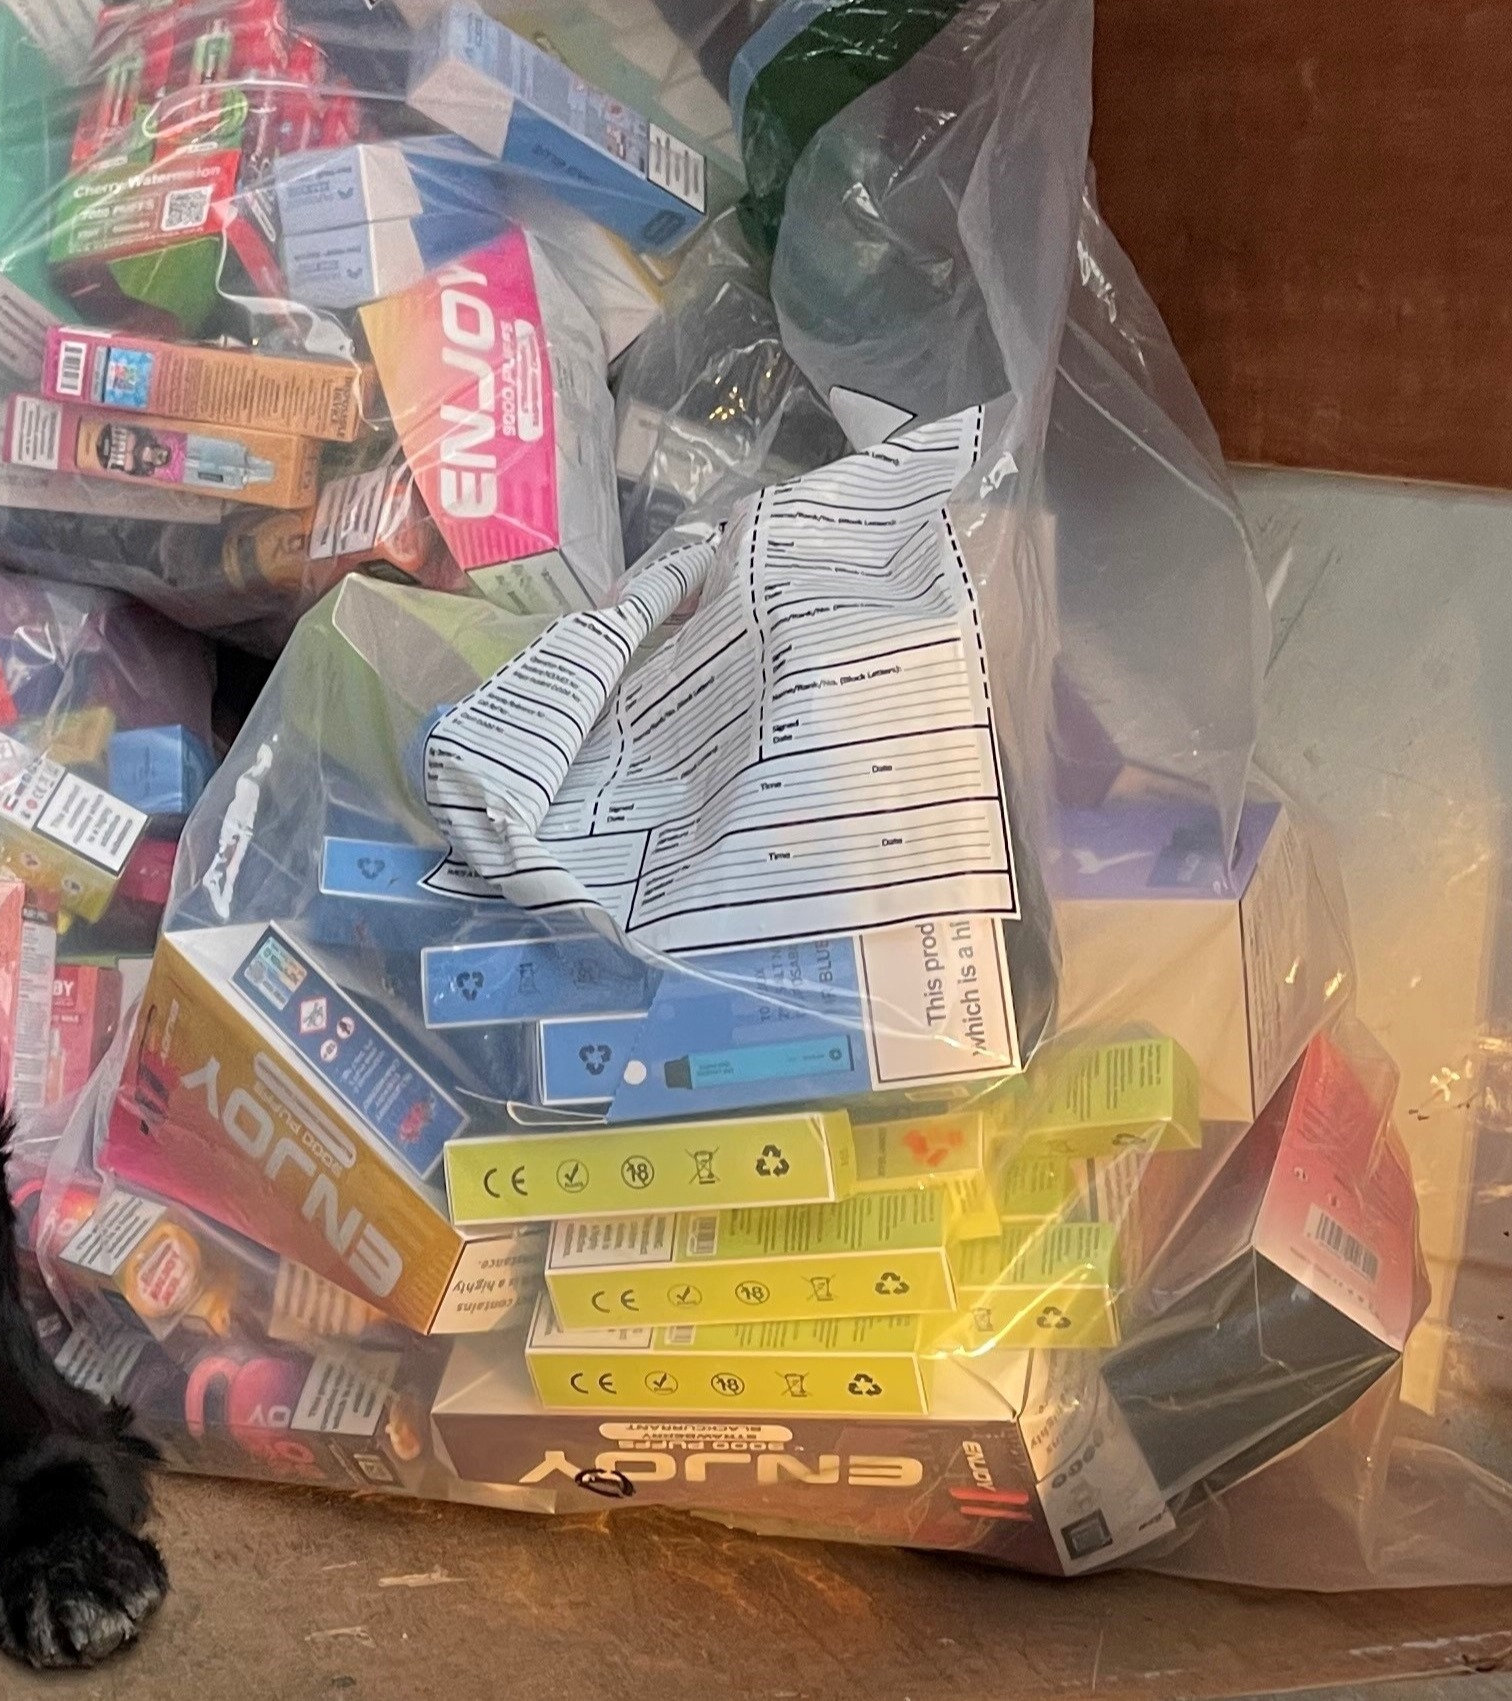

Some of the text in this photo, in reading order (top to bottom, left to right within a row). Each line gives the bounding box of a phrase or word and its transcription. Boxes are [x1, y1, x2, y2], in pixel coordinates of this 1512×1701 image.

[73, 182, 122, 198] Cherry
[438, 263, 498, 518] ENJOY
[773, 718, 800, 733] Signed
[773, 733, 793, 744] Date
[760, 764, 893, 792] Time Date
[768, 837, 903, 861] Time Date
[915, 921, 946, 1027] This prod
[949, 920, 987, 1057] which is a hi
[179, 1054, 405, 1299] ENJOY
[626, 1164, 649, 1182] 18
[451, 1279, 496, 1296] highly
[740, 1286, 763, 1300] 18
[456, 1297, 513, 1314] contains
[716, 1378, 740, 1391] 18
[518, 1449, 925, 1487] ENJOY
[962, 1439, 997, 1493] ENJOY
